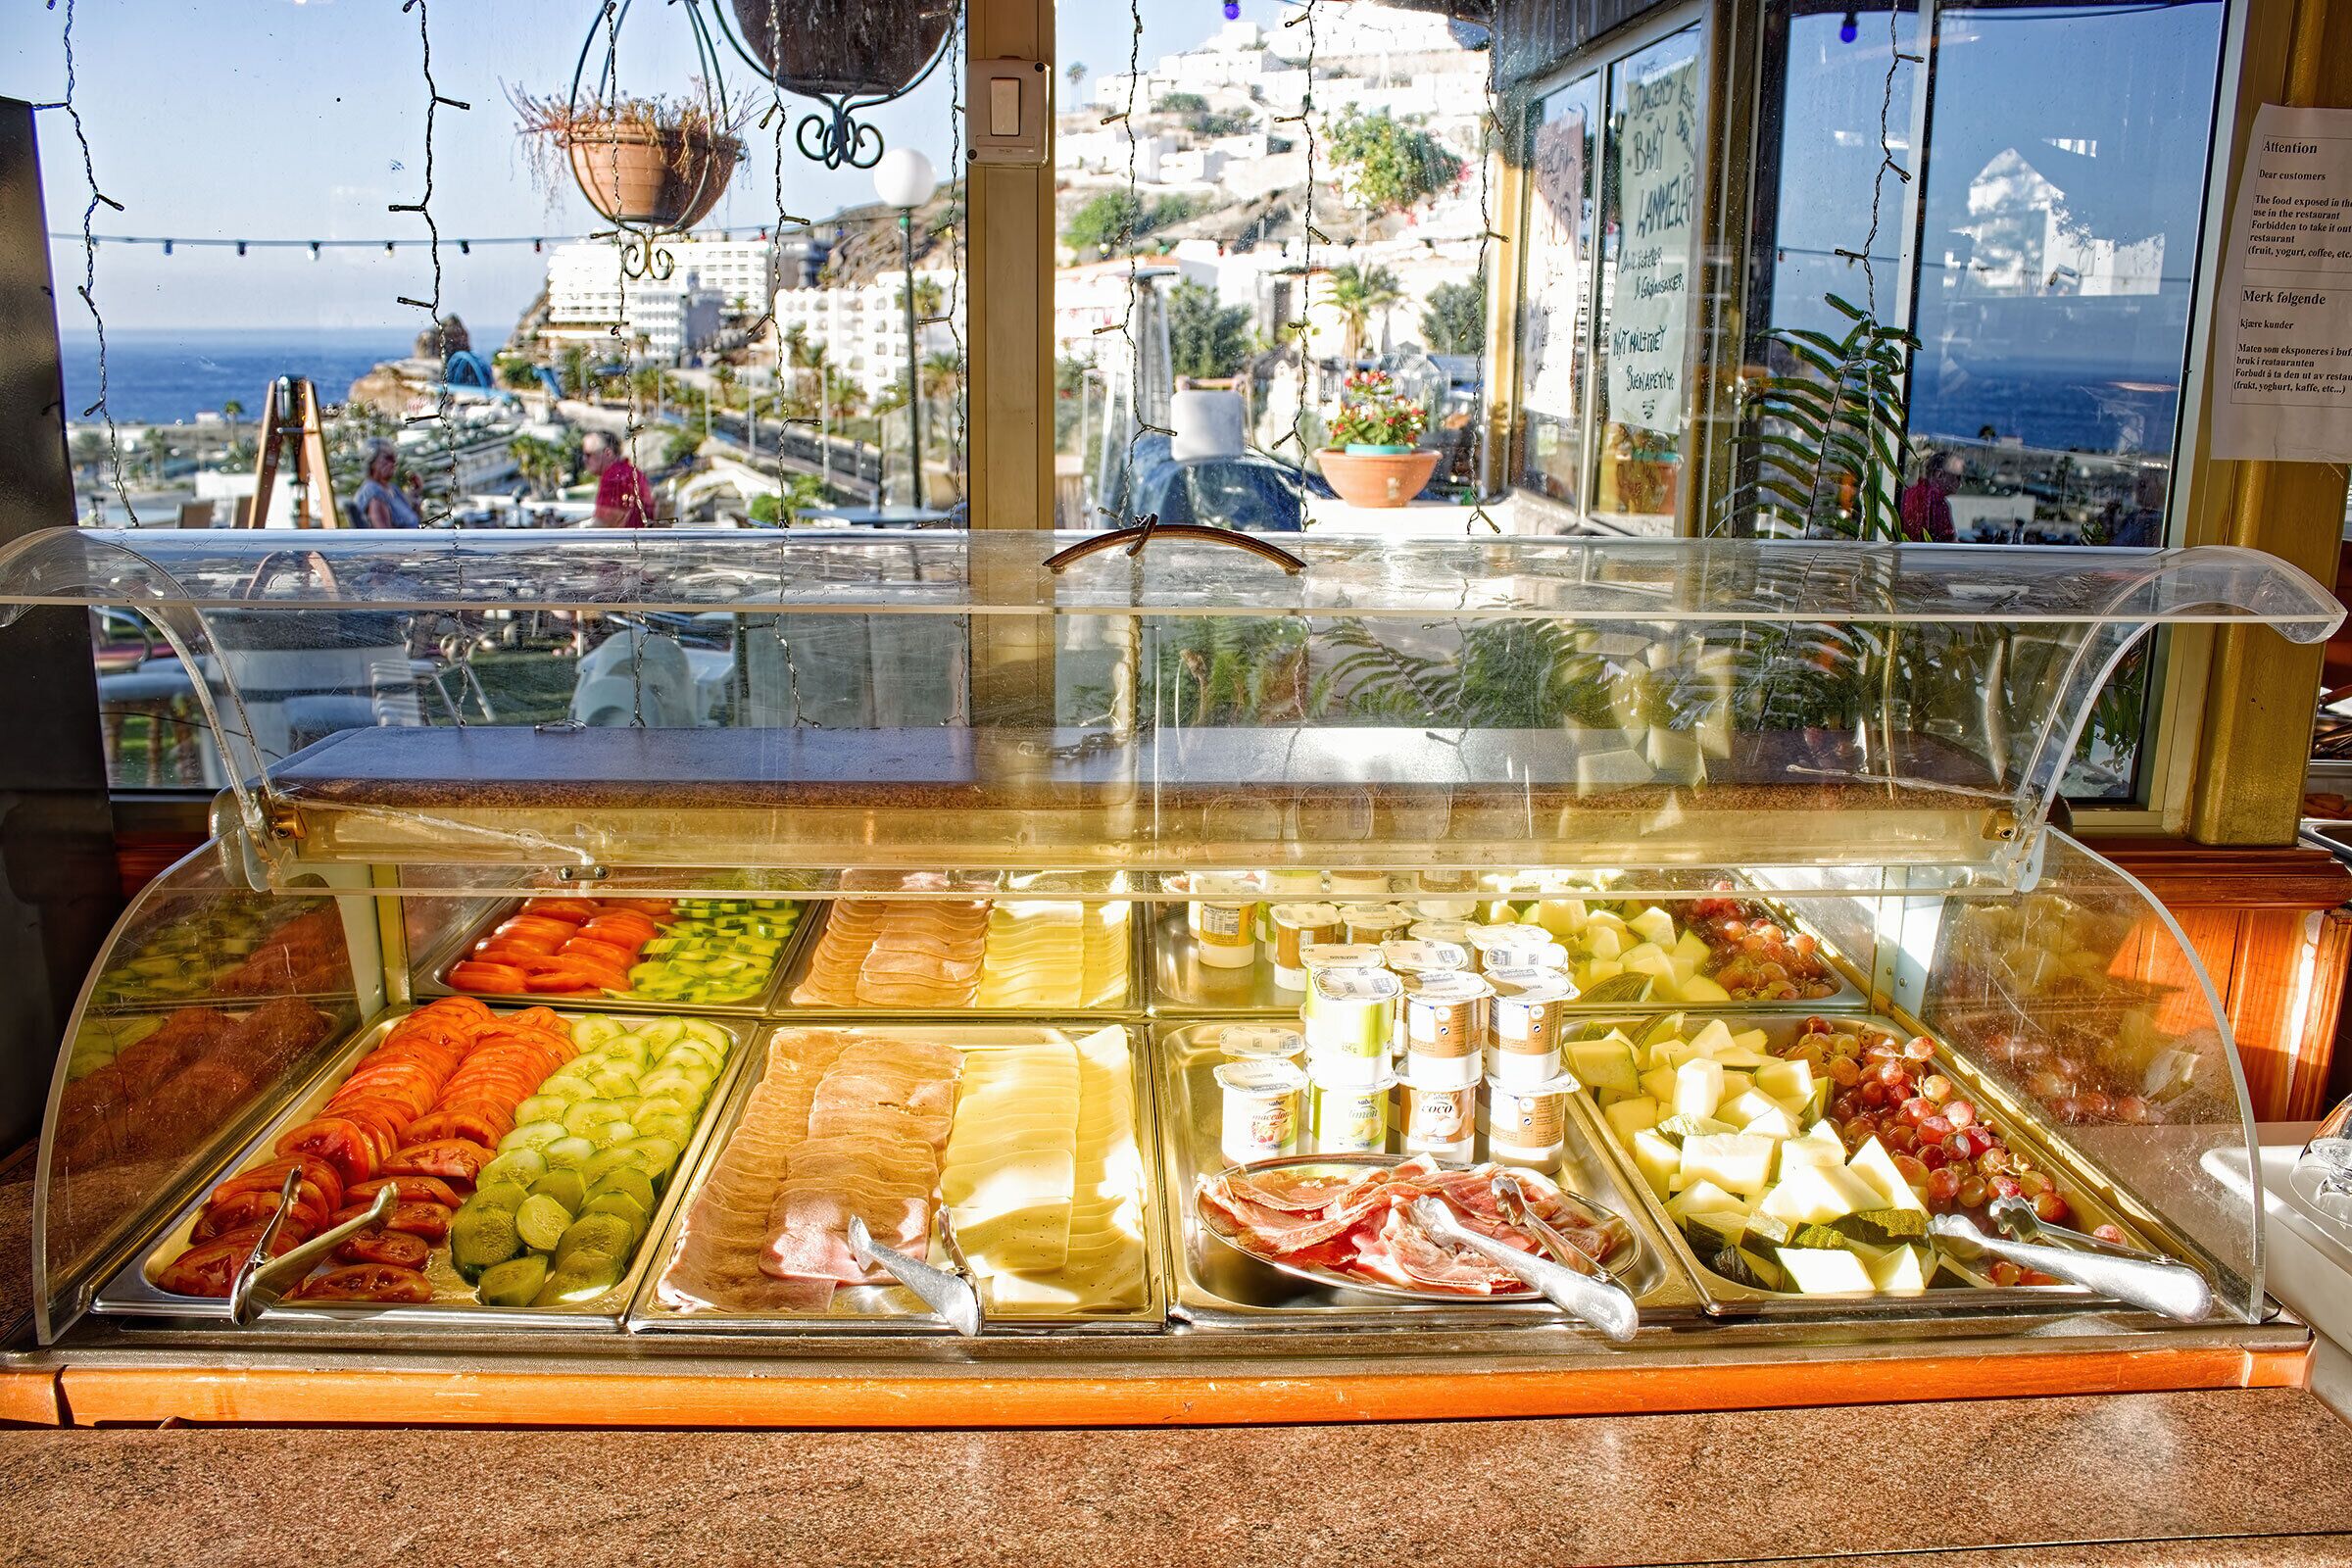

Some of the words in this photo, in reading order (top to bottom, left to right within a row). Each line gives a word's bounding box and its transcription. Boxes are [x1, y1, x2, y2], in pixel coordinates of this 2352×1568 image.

[2263, 140, 2318, 154] Attention
[2259, 169, 2278, 179] Dear
[2278, 172, 2327, 180] customers
[2255, 194, 2271, 204] The
[2272, 195, 2292, 205] food
[2294, 197, 2329, 208] exposed
[2330, 198, 2339, 207] in
[2268, 208, 2277, 218] in
[2278, 209, 2293, 218] the
[2295, 210, 2340, 220] restaurant
[2251, 220, 2296, 231] Forbidden
[2299, 221, 2308, 231] to
[2309, 222, 2328, 232] take
[2328, 223, 2336, 232] it
[2336, 224, 2352, 233] out
[2249, 234, 2295, 243] restaurant
[2275, 248, 2307, 258] yogurt,
[2308, 248, 2334, 259] coffee,
[2242, 290, 2275, 303] Merk
[2277, 292, 2327, 307] følgende
[2239, 318, 2263, 329] kjære
[2263, 319, 2294, 329] kunder
[2237, 343, 2262, 353] Maten
[2280, 345, 2328, 357] eksponeres
[2236, 356, 2256, 366] bruk
[2235, 368, 2266, 378] Forbudt
[2267, 368, 2272, 378] å
[2274, 370, 2281, 379] ta
[2283, 370, 2300, 379] den
[2259, 381, 2293, 392] yoghurt,
[2295, 383, 2320, 393] kaffe,
[1421, 1104, 1453, 1114] coco
